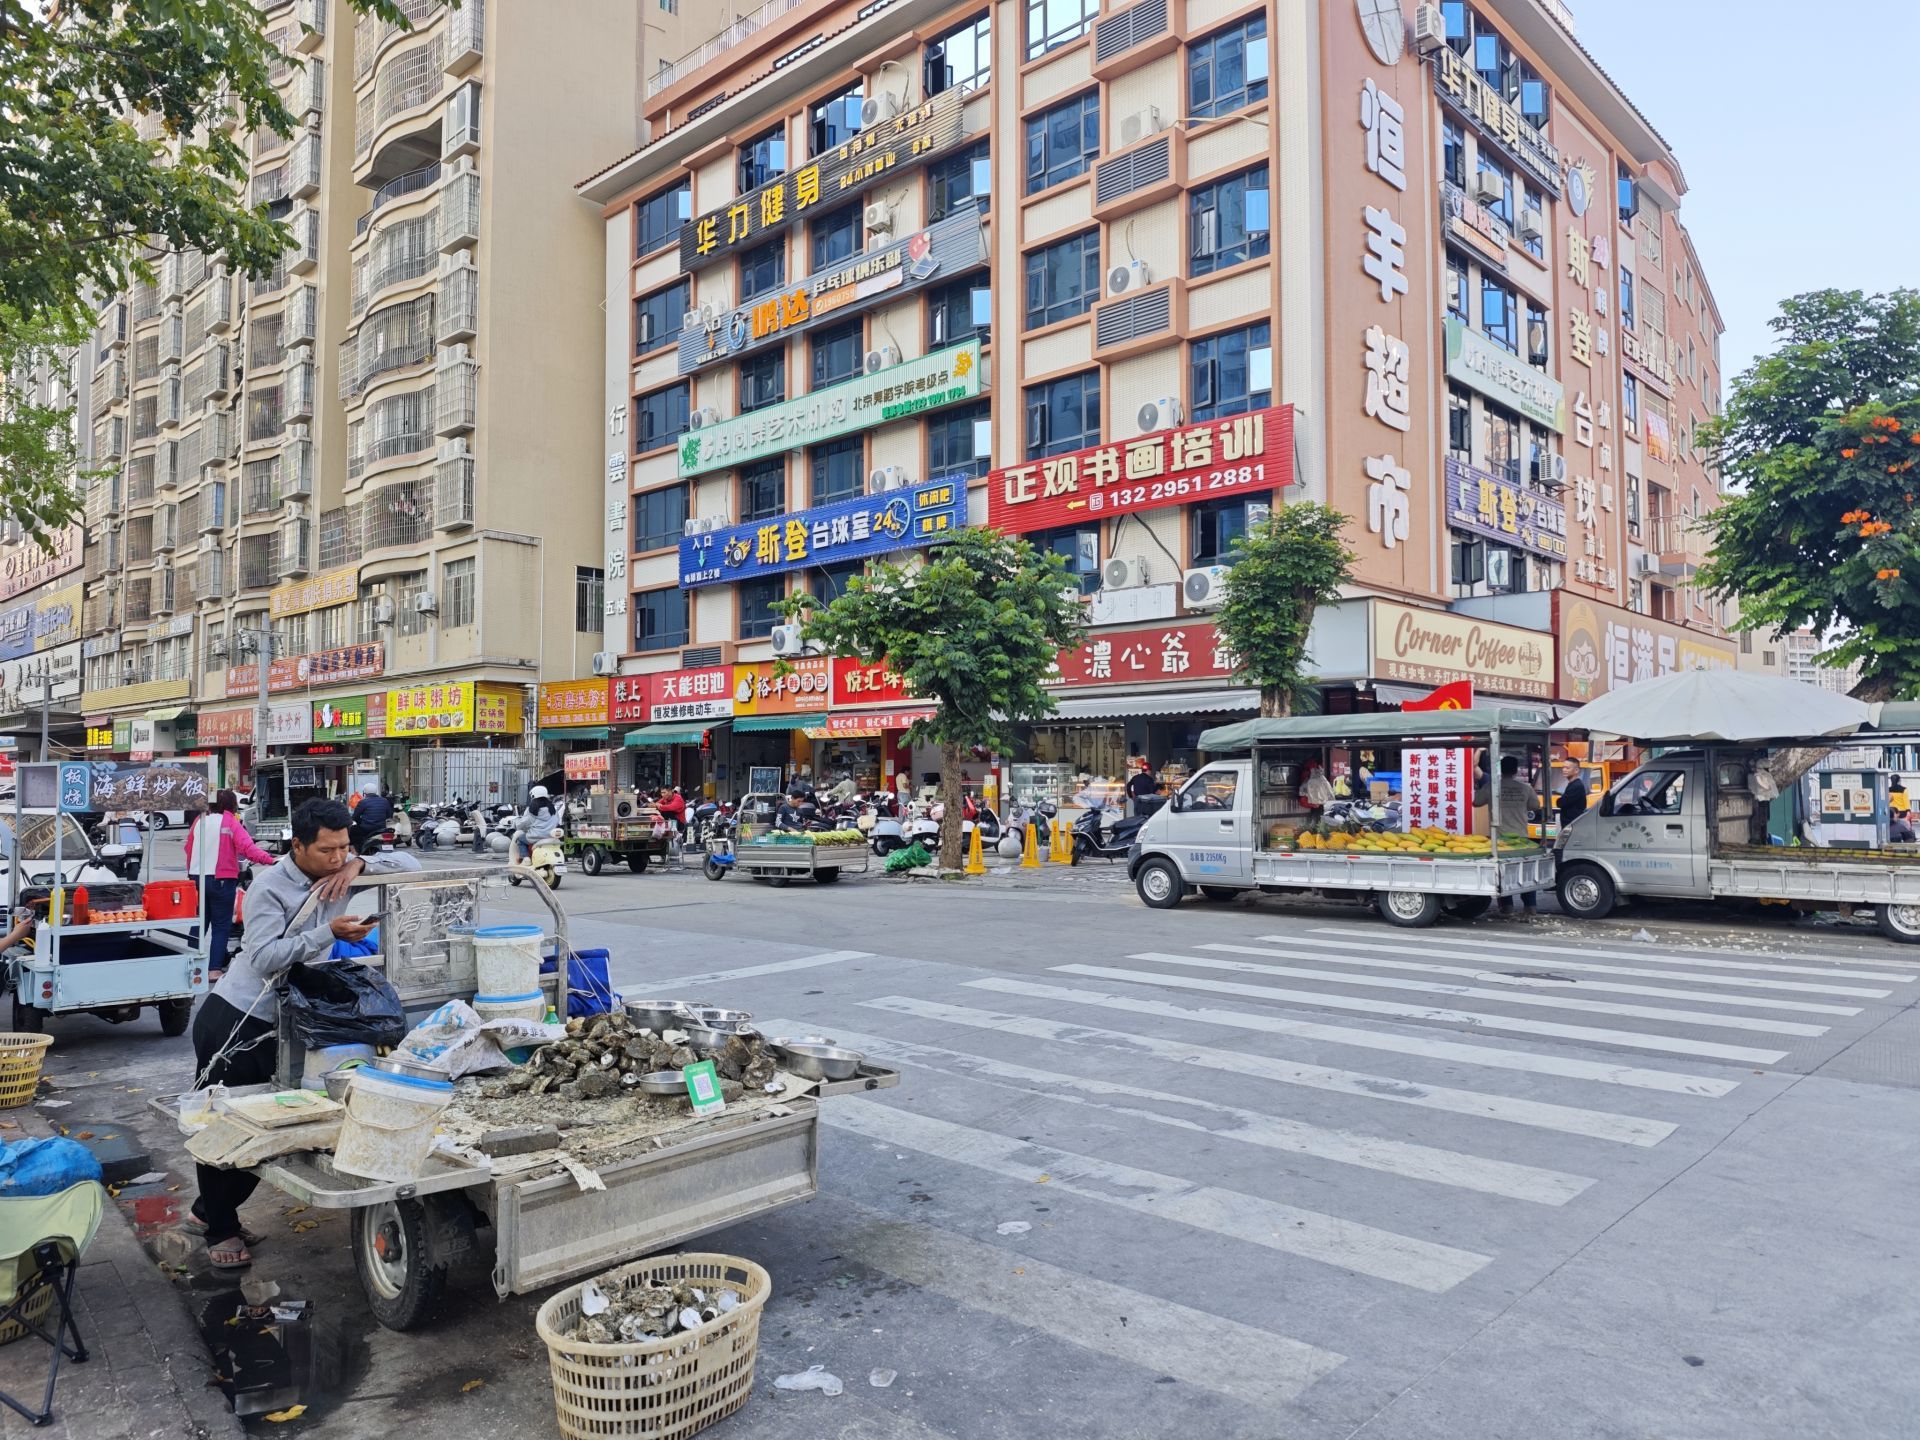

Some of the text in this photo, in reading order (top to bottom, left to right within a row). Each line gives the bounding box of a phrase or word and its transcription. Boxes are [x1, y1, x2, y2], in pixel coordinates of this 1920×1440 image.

[1441, 47, 1520, 153] 华力健身
[696, 165, 820, 256] 华力健身
[813, 248, 900, 298] 乒乓球俱乐部
[703, 317, 721, 334] 入口
[752, 288, 809, 340] 鹏达
[1359, 77, 1412, 549] 恒丰超市
[853, 370, 949, 411] 北京舞蹈学院考级点
[1567, 226, 1597, 529] 斯登台球
[1005, 415, 1263, 504] 正观书画培训
[608, 404, 627, 579] 行雲書院
[918, 488, 951, 508] 休闲吧
[1110, 465, 1264, 507] 132 2951 2881
[874, 510, 893, 532] 24
[922, 516, 948, 532] 棋牌
[1478, 479, 1519, 534] 斯登
[692, 534, 712, 550] 入口
[756, 519, 809, 566] 斯登
[812, 511, 871, 550] 台球室
[684, 568, 720, 584] 电梯直上2楼
[606, 598, 627, 616] 五楼
[1395, 612, 1463, 657] Corner
[1466, 626, 1516, 670] Coffee
[397, 687, 462, 711] 鲜味粥坊
[615, 680, 641, 703] 楼上
[663, 672, 725, 699] 天能电池
[844, 669, 901, 693] 悦汇味
[478, 708, 505, 718] 石锅鱼
[615, 706, 641, 719] 出入口
[654, 703, 712, 720] 恒发维修电动车
[64, 769, 84, 807] 板烧
[94, 774, 207, 801] 海鲜炒饭
[1428, 755, 1439, 825] 党群服务中
[1445, 748, 1457, 833] 民主街道金城
[1206, 852, 1227, 865] 2350Kg
